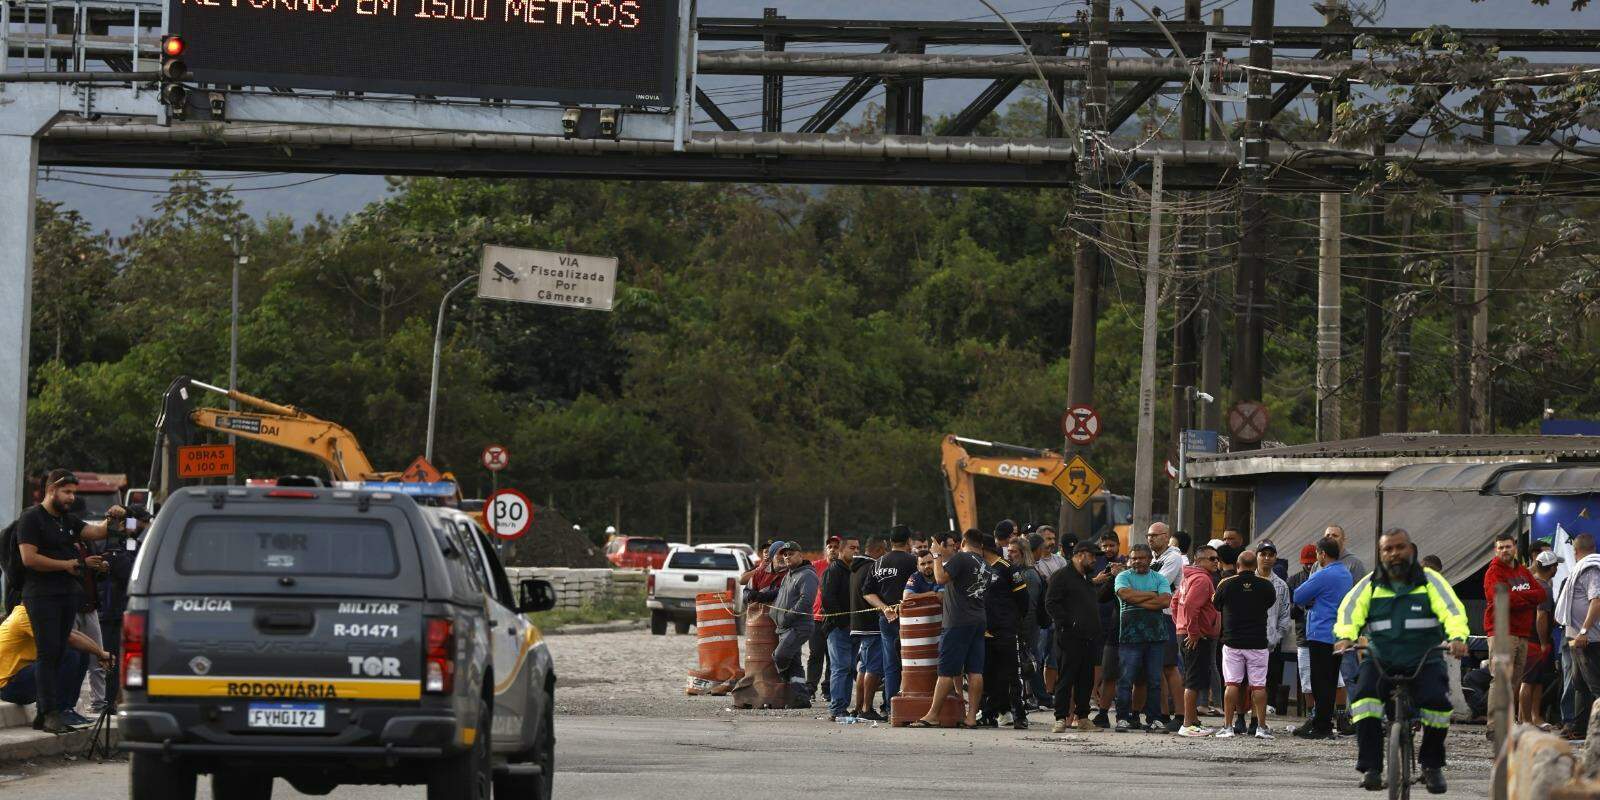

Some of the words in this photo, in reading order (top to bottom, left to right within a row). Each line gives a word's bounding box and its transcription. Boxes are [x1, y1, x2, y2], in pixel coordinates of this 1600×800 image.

[504, 0, 640, 27] METROS
[559, 256, 579, 268] VIA
[531, 265, 605, 282] Fiscalizada
[556, 280, 577, 291] Por
[537, 290, 593, 304] Câmeras
[188, 450, 225, 461] OBRAS
[184, 464, 192, 473] A
[197, 462, 216, 472] 100
[220, 463, 230, 471] m
[998, 463, 1040, 480] CASE
[496, 500, 523, 521] 30
[256, 532, 309, 551] TOR
[172, 597, 233, 612] POLÍCIA
[338, 602, 400, 615] MILITAR
[333, 623, 399, 638] R-01471
[348, 655, 401, 677] TOR
[227, 680, 337, 698] RODOVIÁRIA
